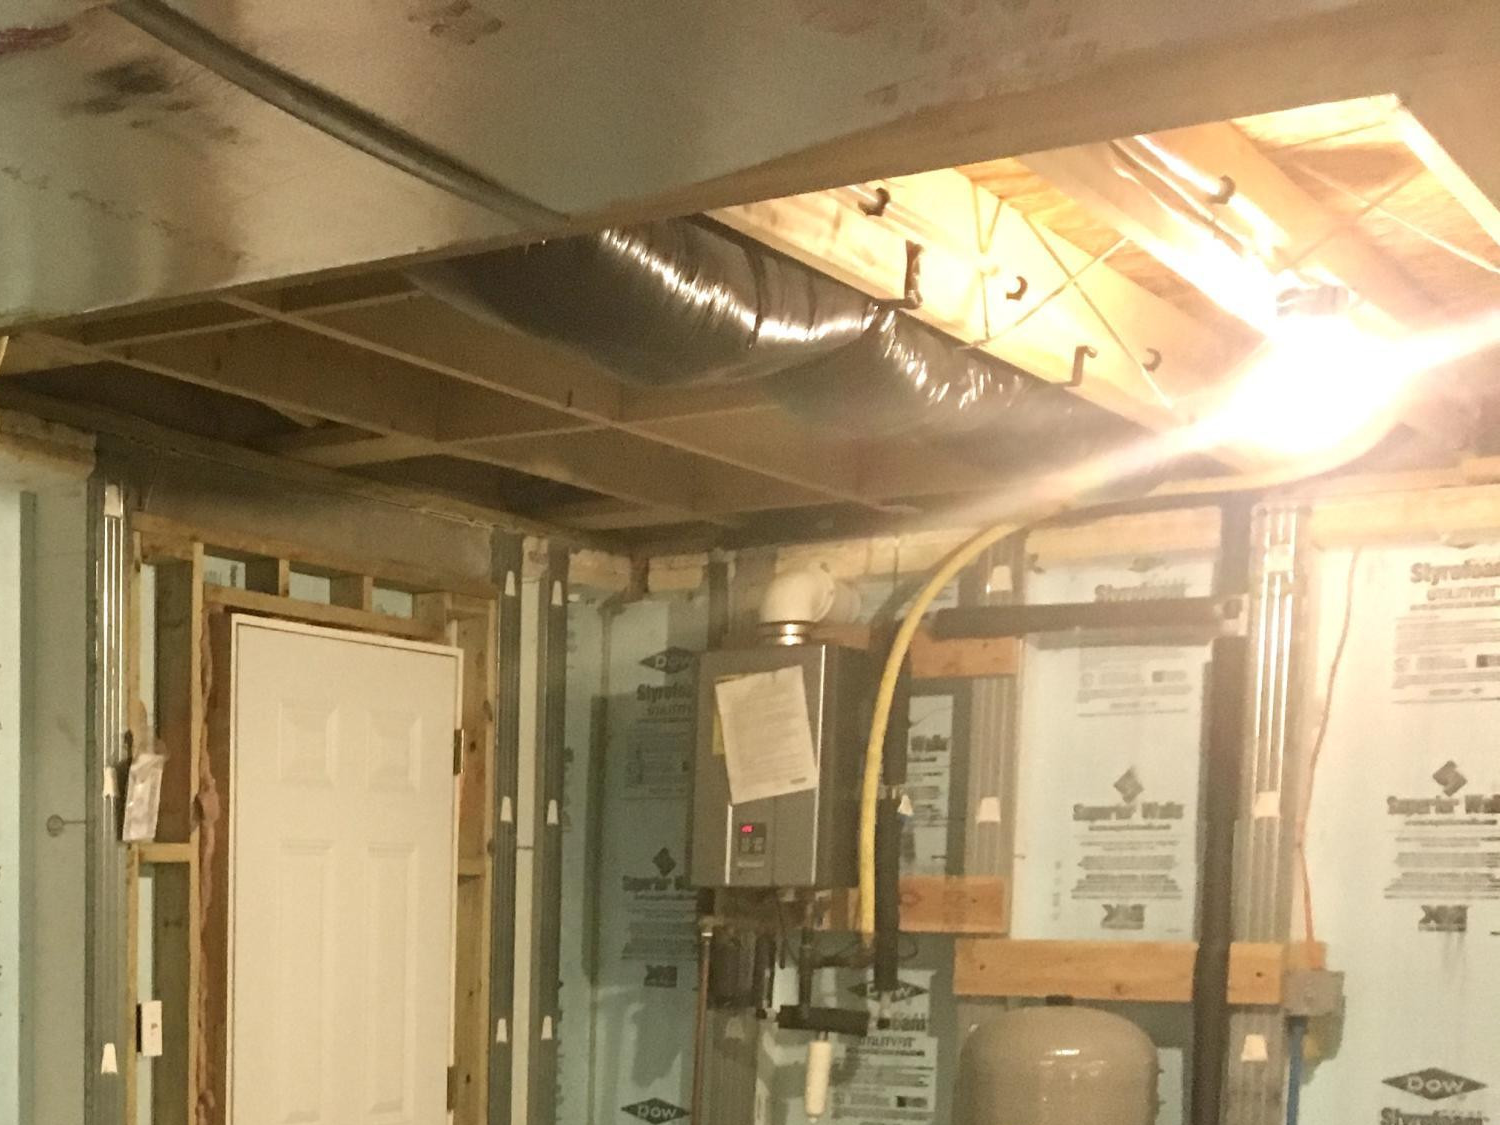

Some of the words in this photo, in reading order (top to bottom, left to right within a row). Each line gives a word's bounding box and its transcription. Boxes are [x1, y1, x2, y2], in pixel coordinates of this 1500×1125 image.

[1410, 562, 1500, 586] Styrofoa
[1408, 1075, 1464, 1093] DOW
[637, 1104, 677, 1119] DOW
